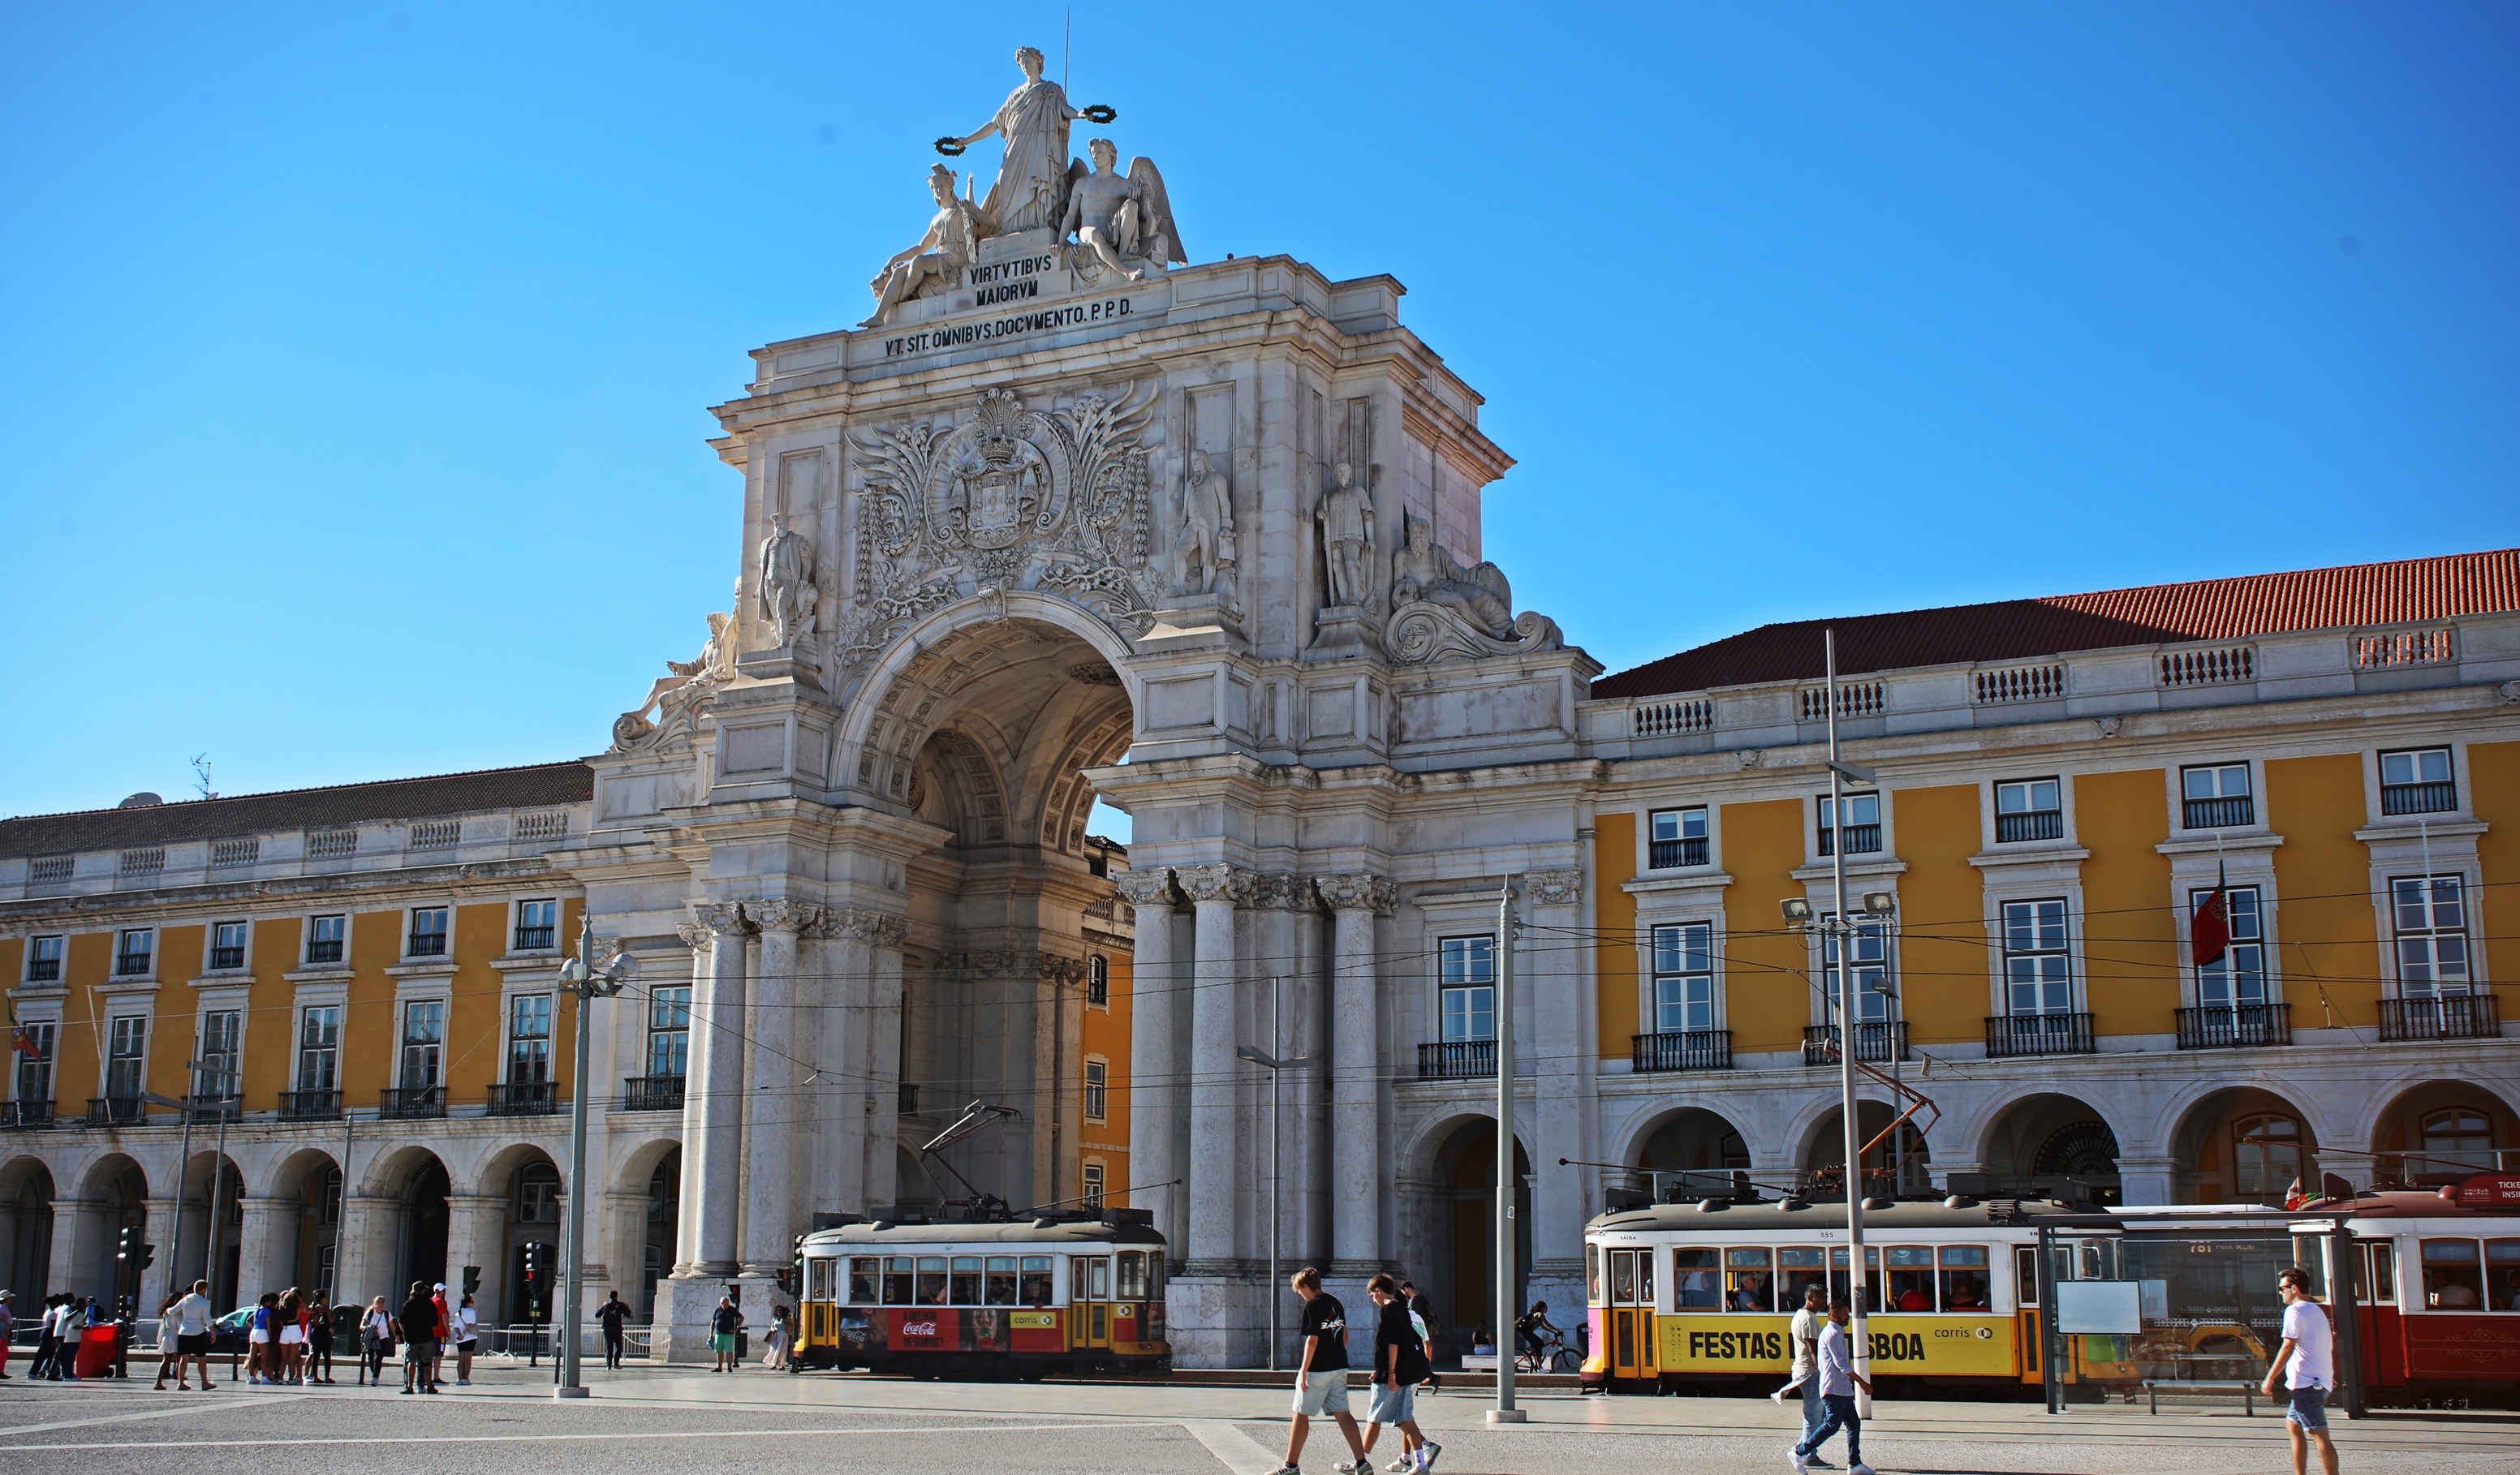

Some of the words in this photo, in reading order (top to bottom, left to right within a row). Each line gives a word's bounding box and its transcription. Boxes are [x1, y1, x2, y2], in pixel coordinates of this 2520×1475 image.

[970, 255, 1052, 285] VIRTVTIBVS
[976, 280, 1038, 307] MAIORVM
[909, 1311, 937, 1322] MELHOR
[1014, 1315, 1037, 1324] carris
[1934, 1327, 1970, 1338] carris
[1689, 1331, 1781, 1359] FESTAS
